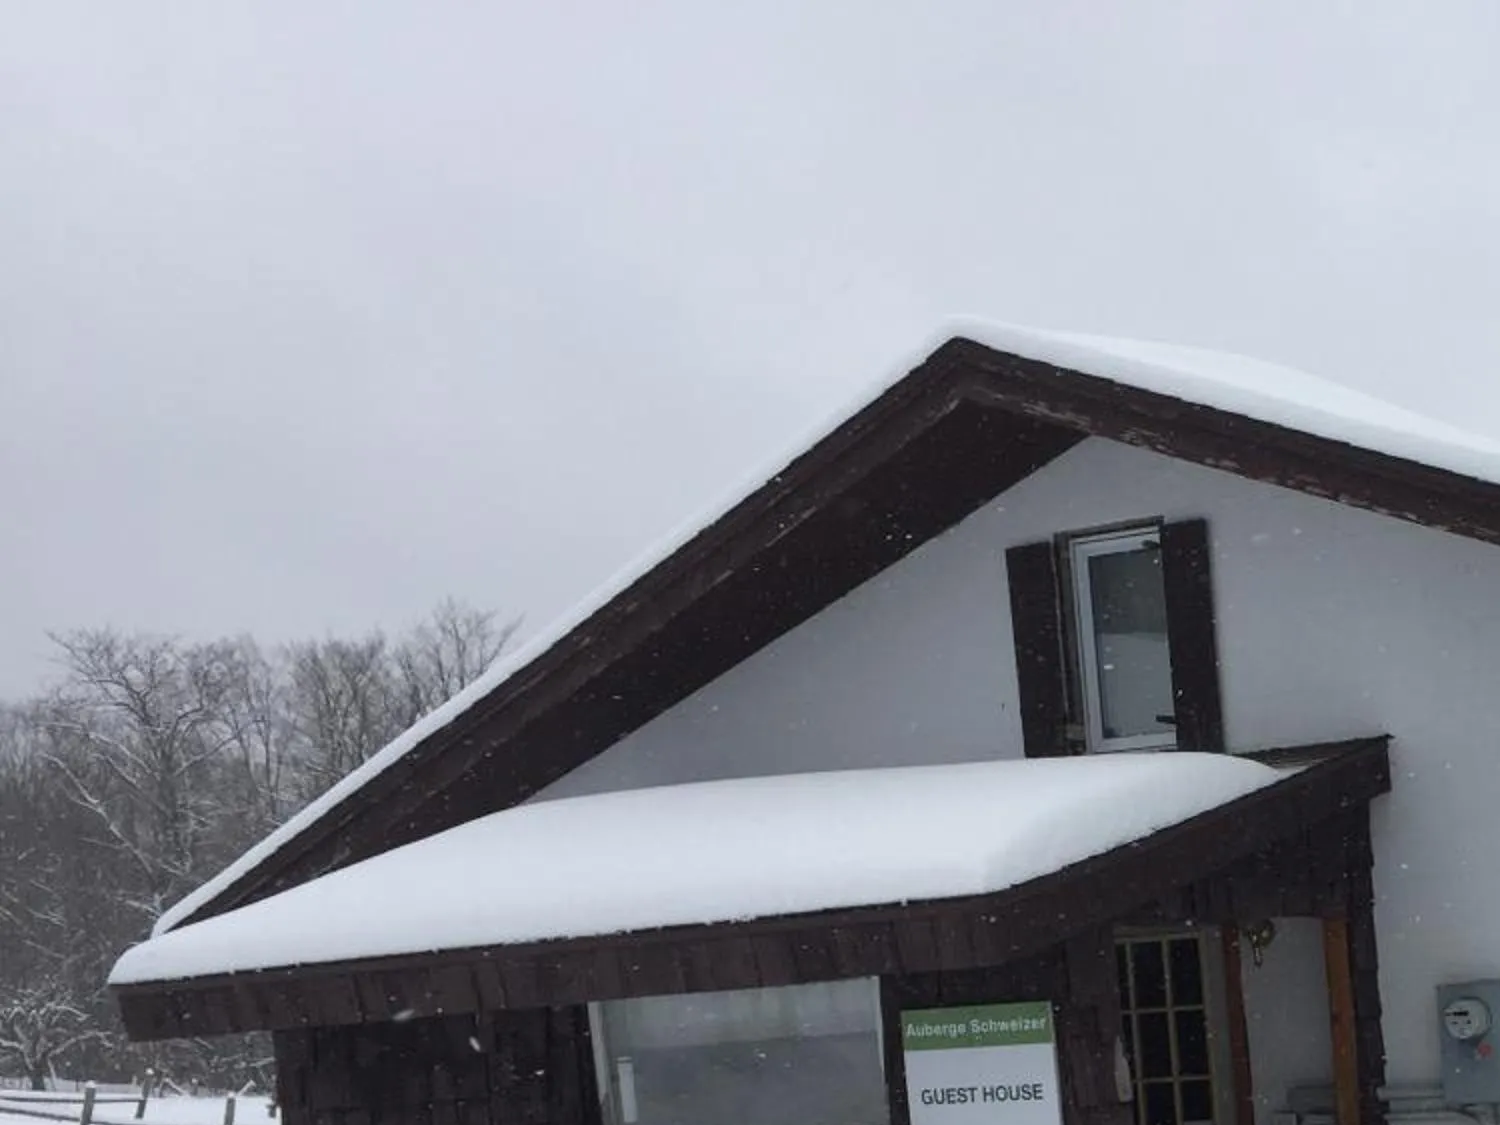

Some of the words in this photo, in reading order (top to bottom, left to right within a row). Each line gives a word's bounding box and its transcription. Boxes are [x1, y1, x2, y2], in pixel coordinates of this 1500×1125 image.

[906, 1021, 967, 1038] Auberge
[970, 1016, 1047, 1034] Schweizer
[921, 1087, 978, 1105] GUEST
[983, 1083, 1044, 1103] HOUSE
